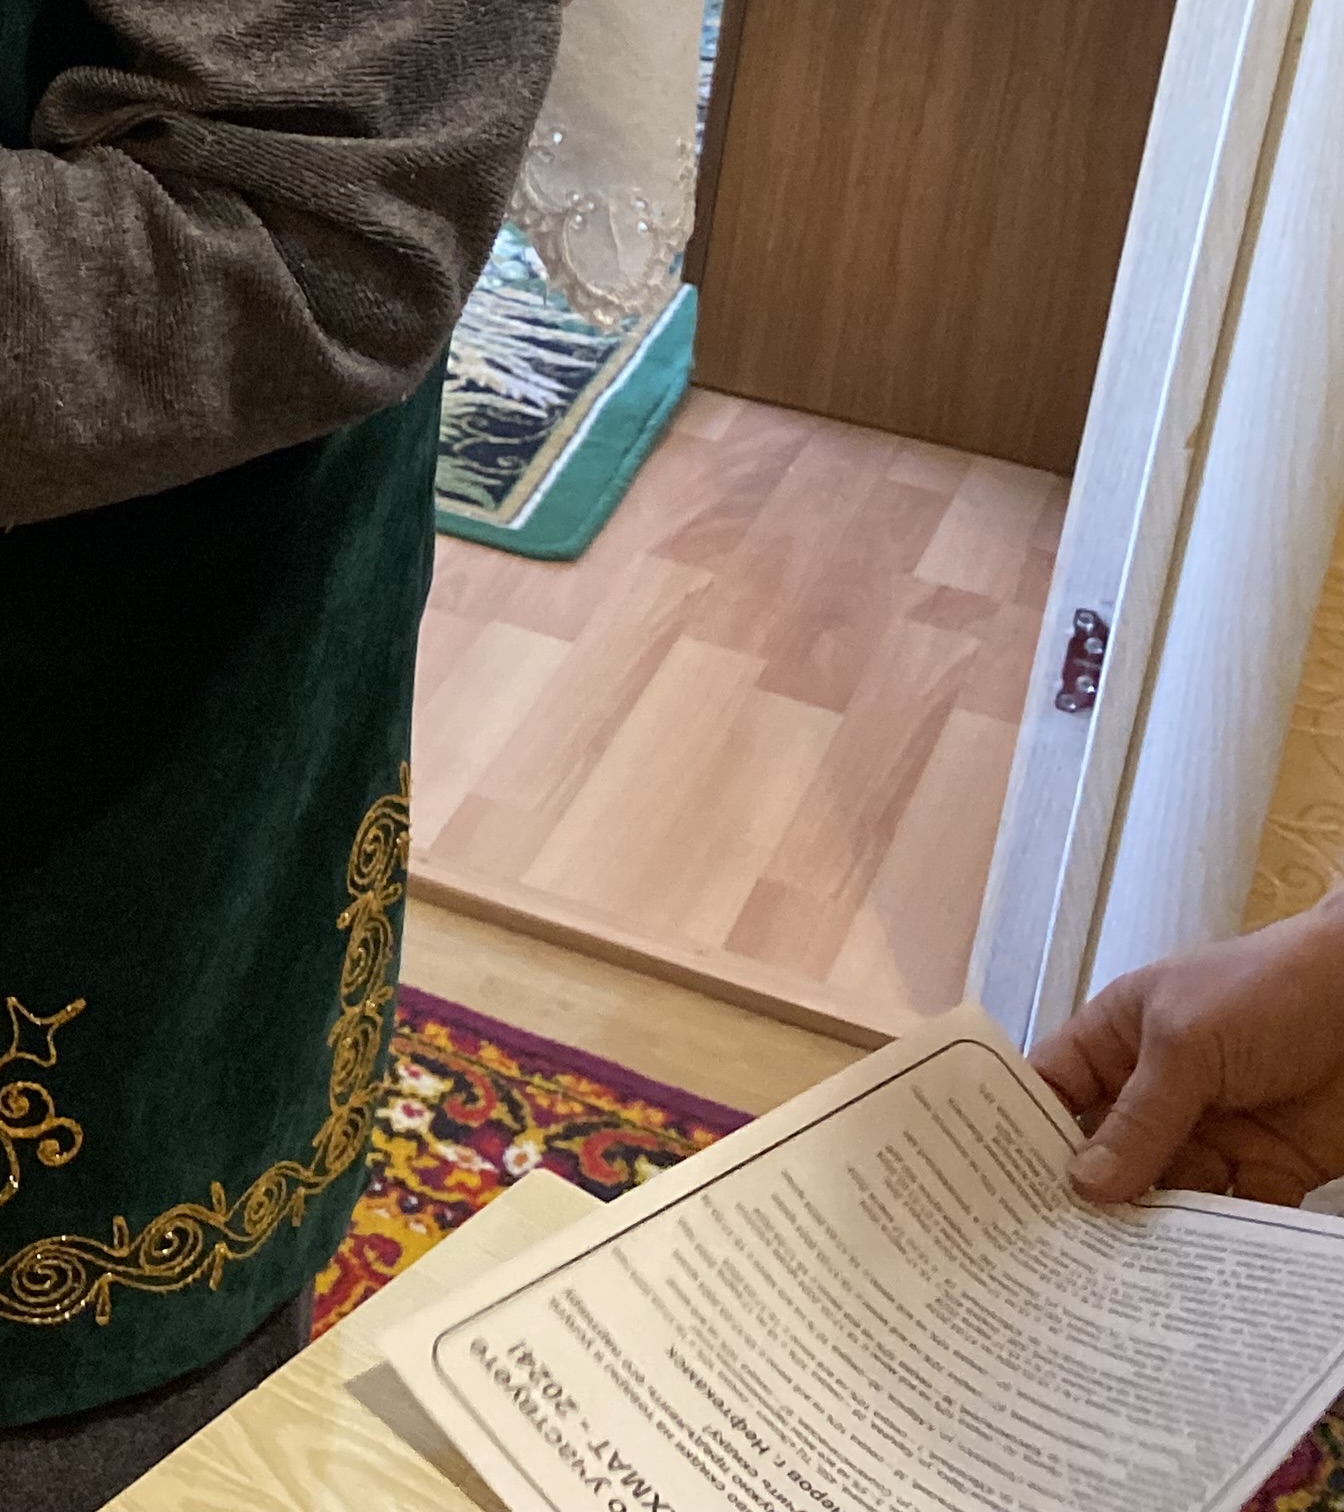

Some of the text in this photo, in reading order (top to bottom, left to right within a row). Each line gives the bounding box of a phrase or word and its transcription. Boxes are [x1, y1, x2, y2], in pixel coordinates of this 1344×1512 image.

[665, 1344, 770, 1455] Нефтекамск
[586, 1433, 673, 1512] ХМАТ
[759, 1476, 796, 1512] чить
